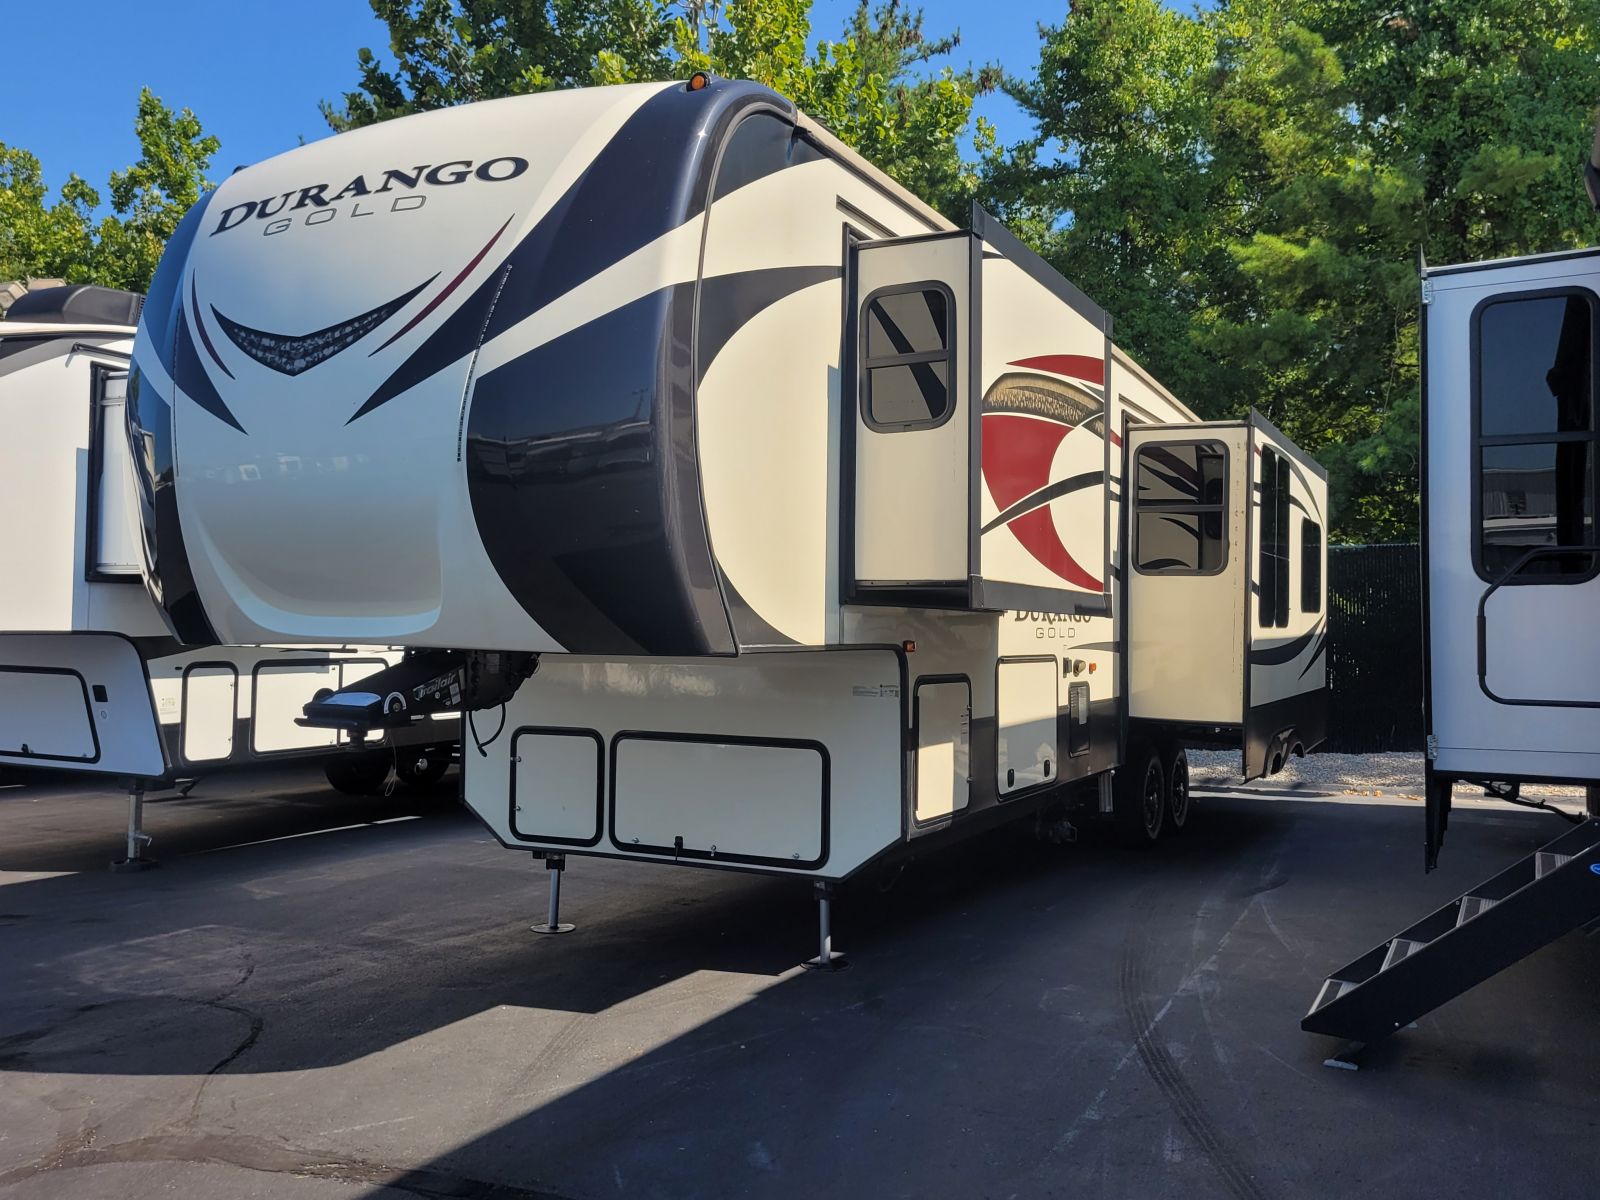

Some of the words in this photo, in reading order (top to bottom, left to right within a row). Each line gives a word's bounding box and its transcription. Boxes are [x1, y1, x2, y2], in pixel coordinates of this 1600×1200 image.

[209, 156, 530, 238] DURANGO
[263, 194, 427, 237] GOLD
[1035, 627, 1076, 639] GOLD
